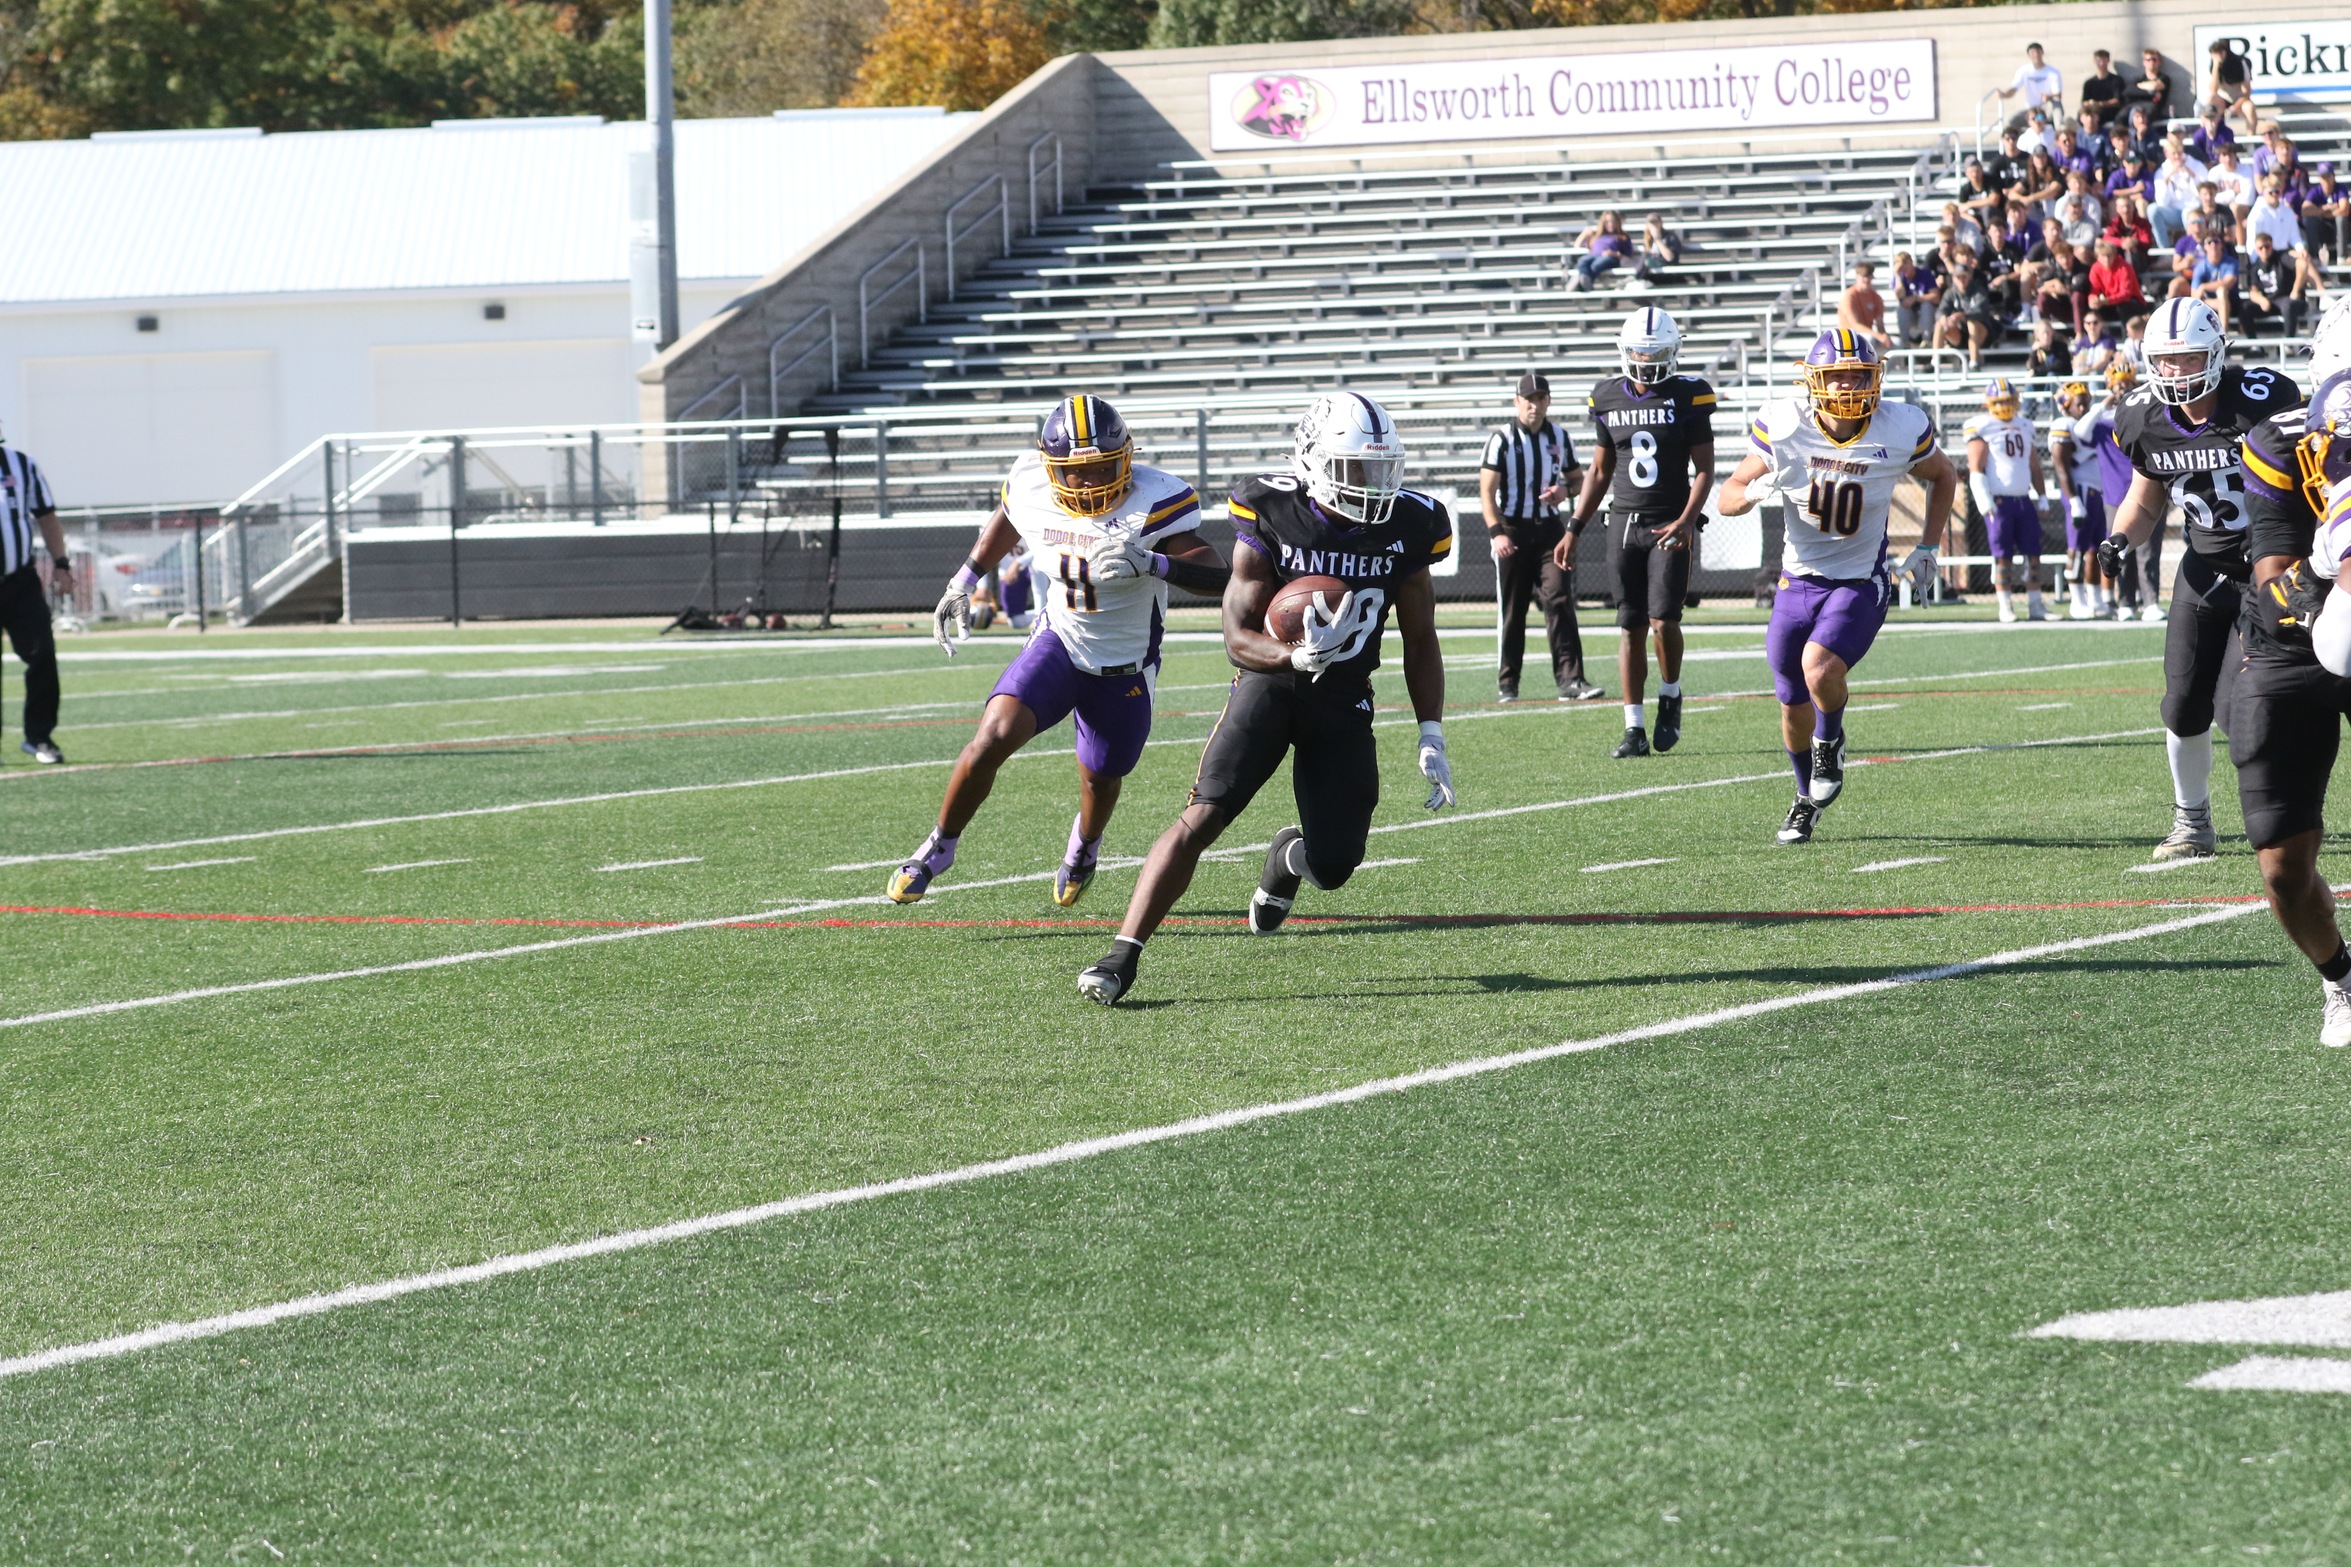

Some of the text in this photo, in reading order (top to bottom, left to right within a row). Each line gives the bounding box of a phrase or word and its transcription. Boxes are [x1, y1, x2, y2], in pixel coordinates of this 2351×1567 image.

[1360, 57, 1912, 124] Ellsworth Community College
[1607, 408, 1676, 428] PANTHERS
[1628, 430, 1659, 488] 8
[2005, 433, 2024, 457] 69
[2151, 447, 2242, 471] PANTHERS
[1808, 455, 1870, 477] DODGE CITY
[1808, 477, 1864, 537] 40
[2171, 465, 2249, 530] 65
[1042, 528, 1078, 547] DODGE
[1279, 542, 1396, 578] PANTHERS
[1060, 551, 1099, 613] 11
